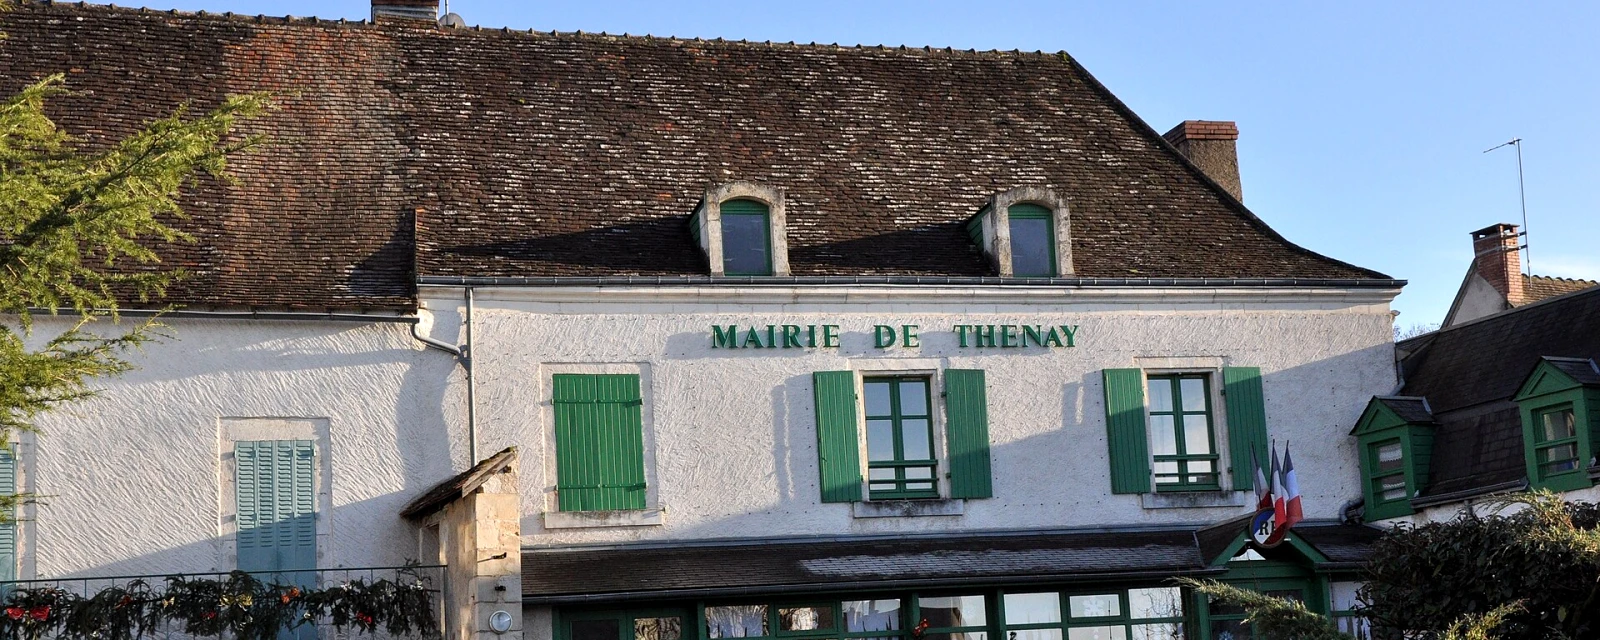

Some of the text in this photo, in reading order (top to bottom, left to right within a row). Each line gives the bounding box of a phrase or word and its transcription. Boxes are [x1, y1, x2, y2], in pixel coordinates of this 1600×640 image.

[711, 324, 1079, 349] MAIRIE DE THENAY
